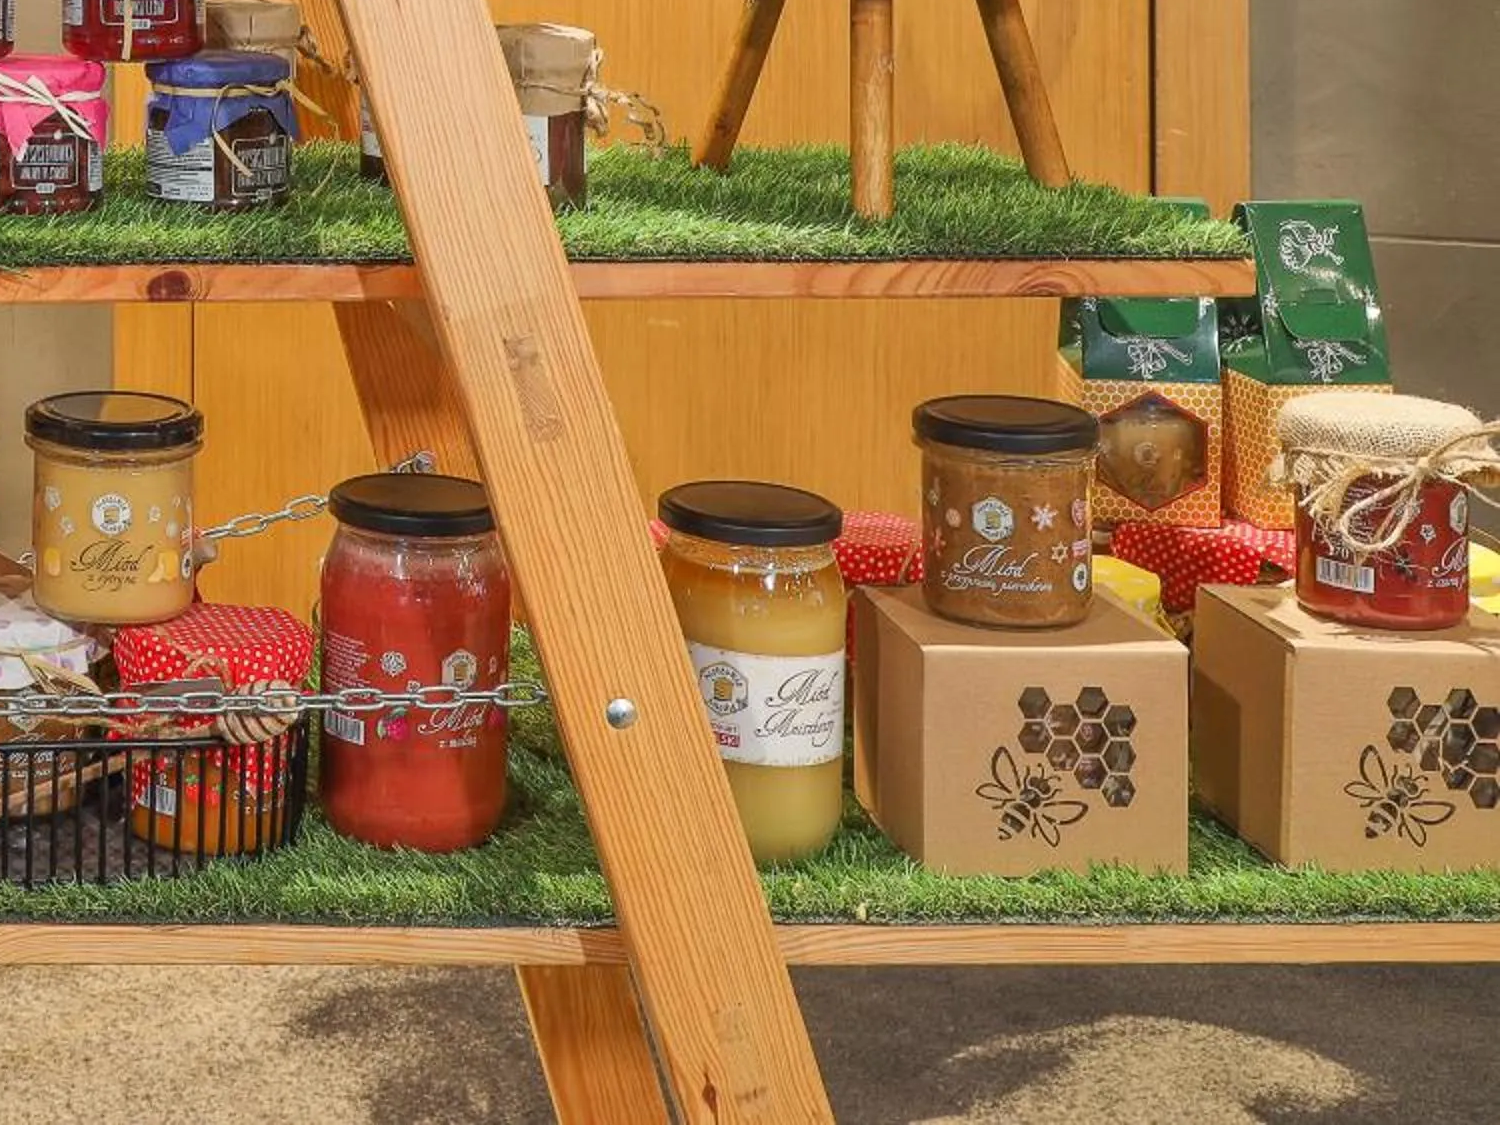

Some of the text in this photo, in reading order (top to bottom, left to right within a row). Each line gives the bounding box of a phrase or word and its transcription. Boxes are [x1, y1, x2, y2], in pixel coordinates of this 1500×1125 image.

[69, 539, 155, 572] Miód
[952, 544, 1040, 577] Miód
[764, 668, 839, 707] Miód
